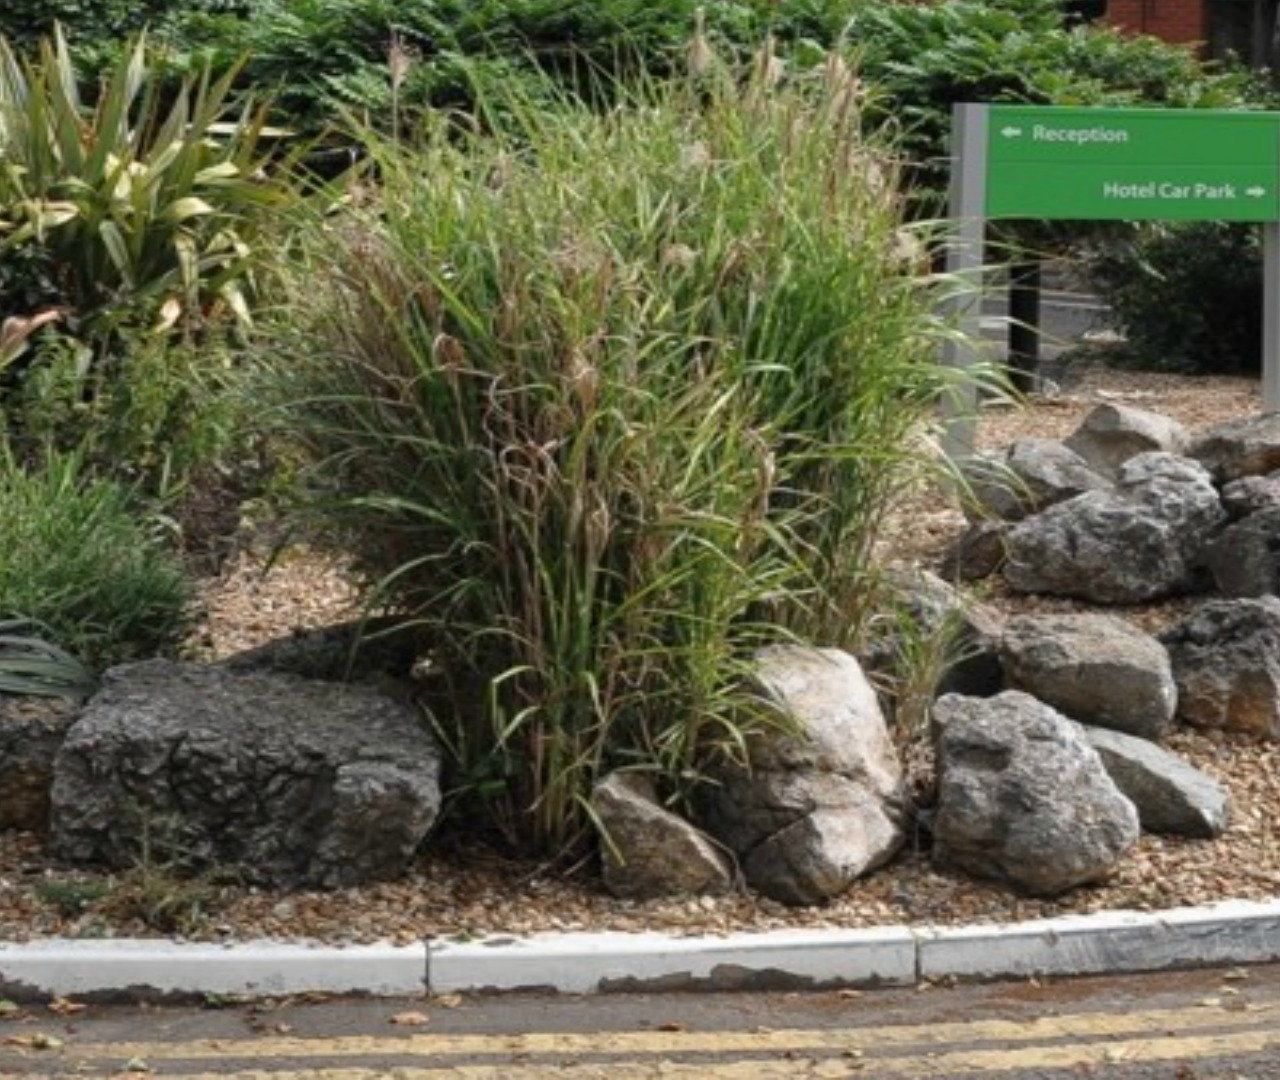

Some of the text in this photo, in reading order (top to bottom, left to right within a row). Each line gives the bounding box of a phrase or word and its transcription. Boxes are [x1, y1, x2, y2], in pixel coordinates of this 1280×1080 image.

[1032, 125, 1129, 145] Reception
[1103, 182, 1236, 200] Hotel Car Park
